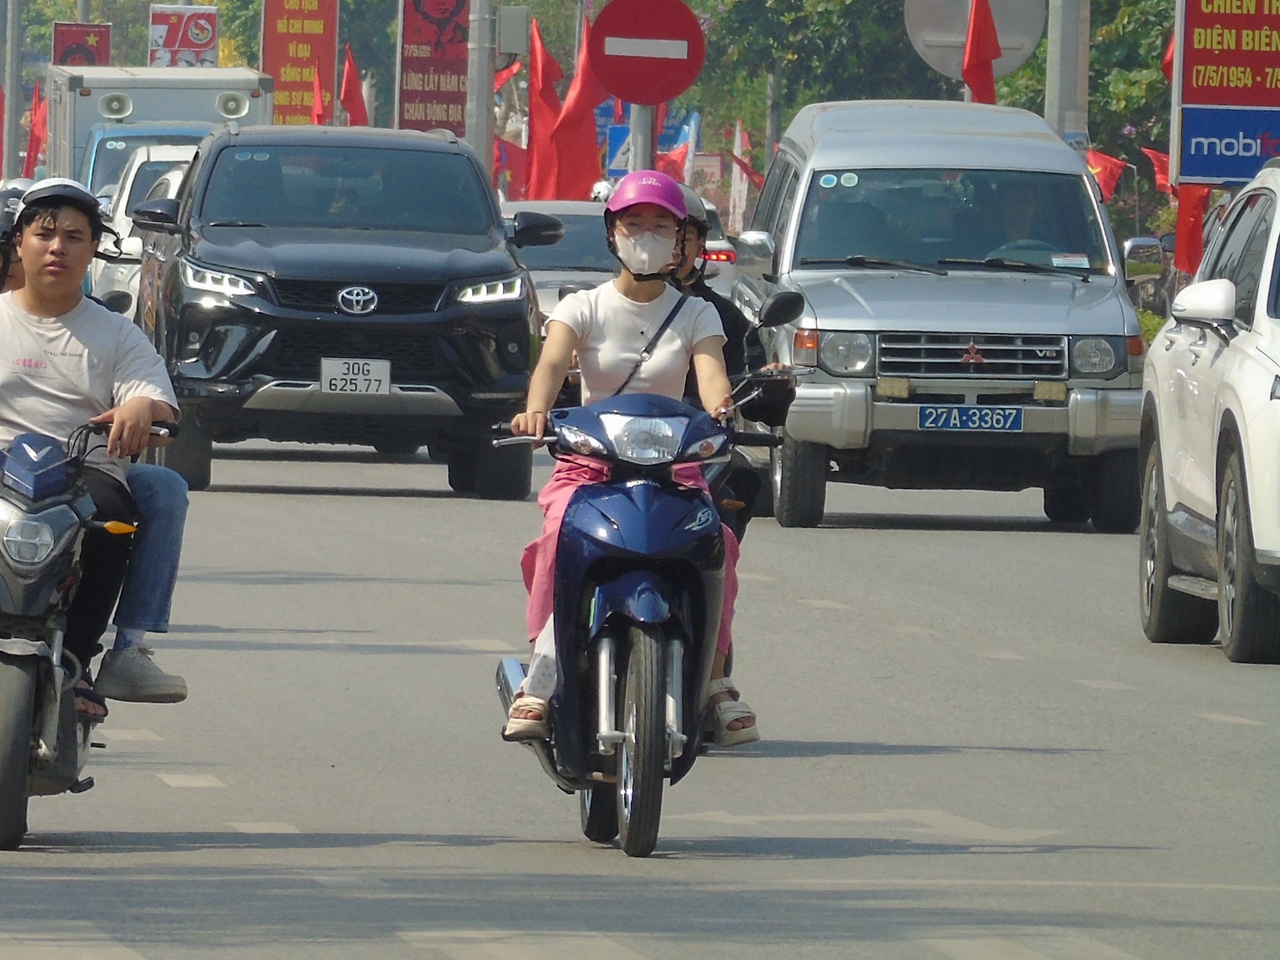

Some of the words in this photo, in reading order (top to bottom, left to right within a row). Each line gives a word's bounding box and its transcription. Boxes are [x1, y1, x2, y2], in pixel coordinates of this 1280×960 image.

[1193, 24, 1236, 54] ĐIỆN
[1192, 65, 1253, 88] (7/5/1954
[1035, 349, 1057, 358] V6
[342, 361, 370, 376] 30G
[329, 377, 382, 392] 625.77
